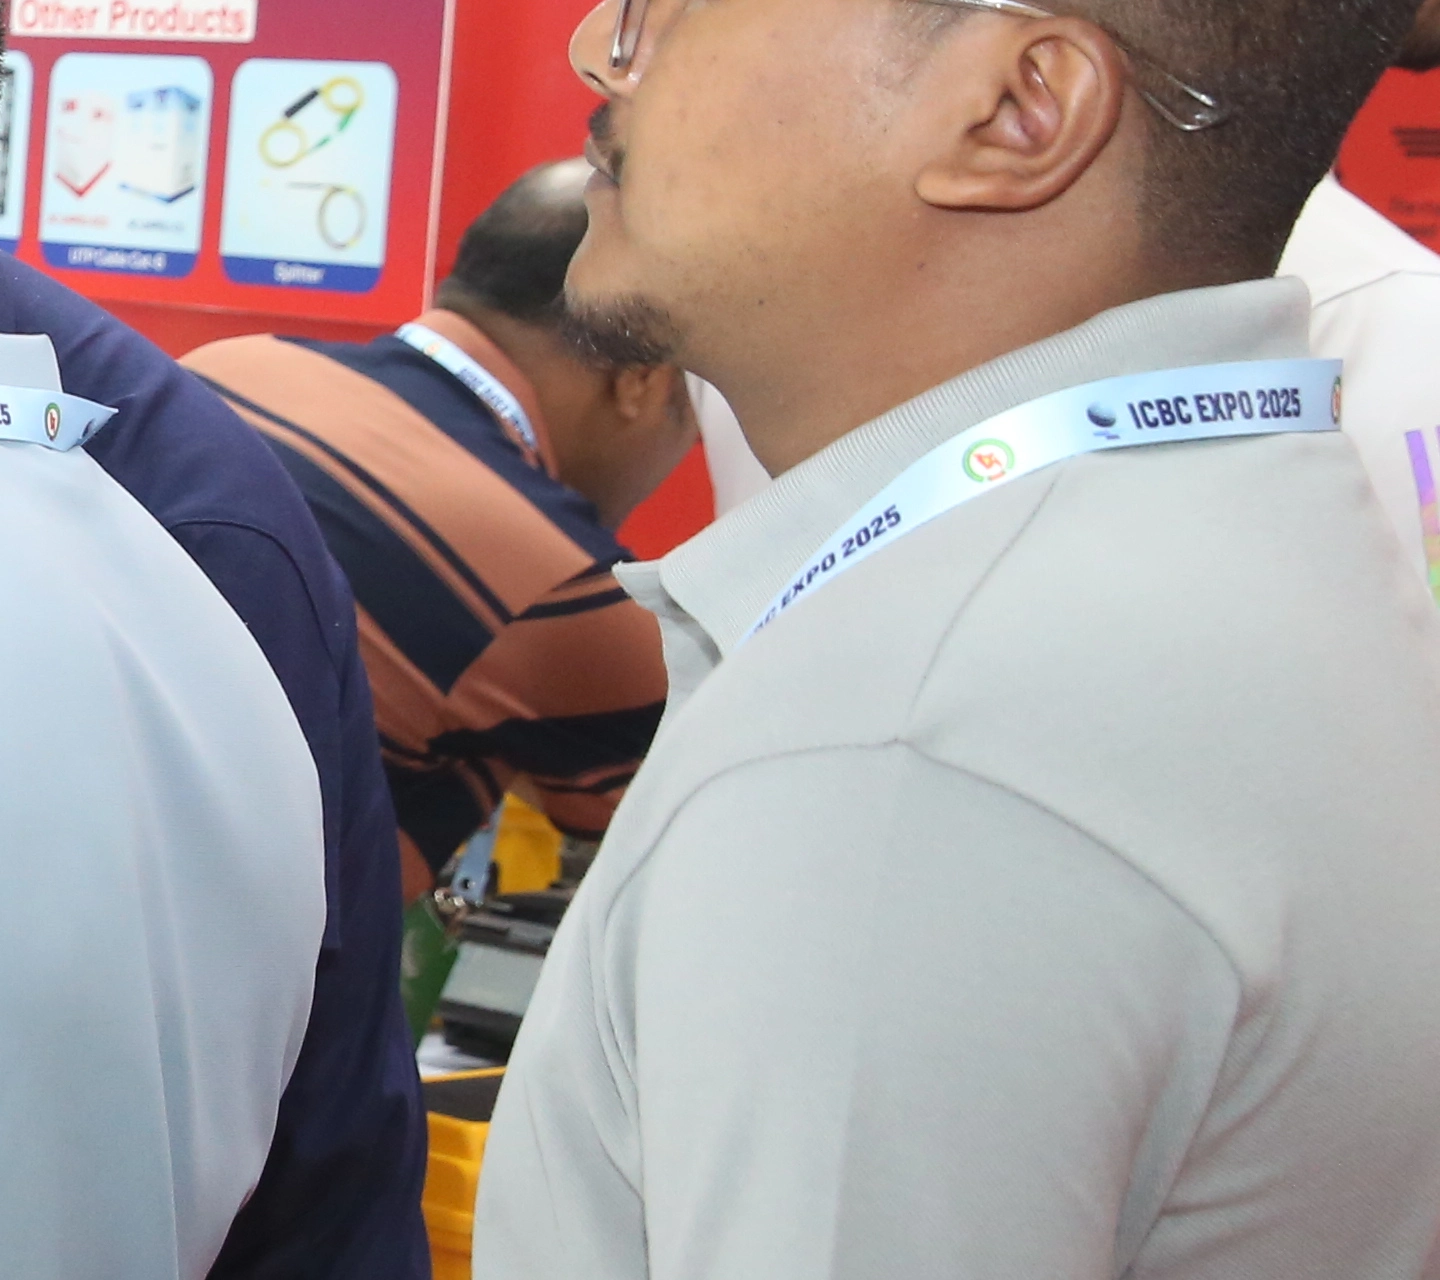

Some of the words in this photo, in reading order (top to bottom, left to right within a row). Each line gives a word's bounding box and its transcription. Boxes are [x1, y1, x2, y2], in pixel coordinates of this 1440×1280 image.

[109, 0, 246, 35] Products
[1127, 393, 1194, 430] ICBC
[1194, 390, 1254, 425] EXPO
[1257, 386, 1302, 420] 2025
[781, 552, 836, 610] EXPO
[841, 504, 902, 559] 2025
